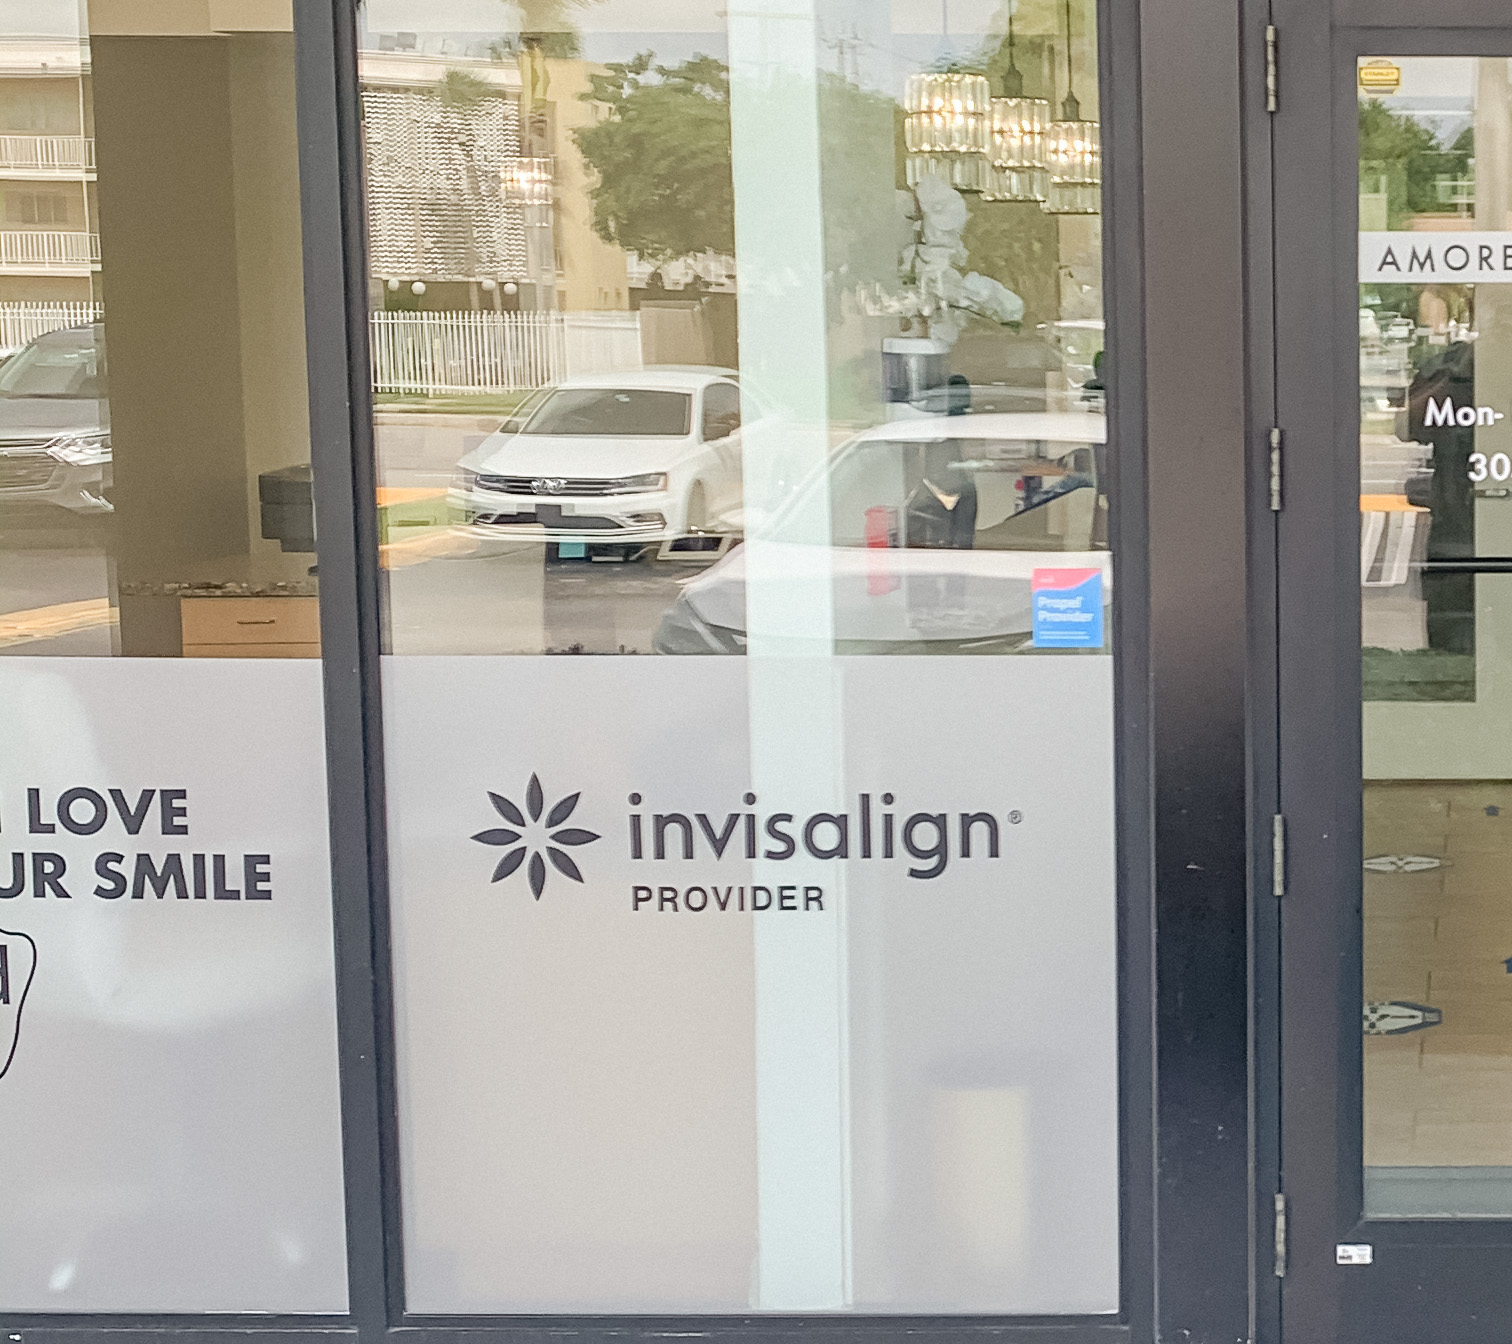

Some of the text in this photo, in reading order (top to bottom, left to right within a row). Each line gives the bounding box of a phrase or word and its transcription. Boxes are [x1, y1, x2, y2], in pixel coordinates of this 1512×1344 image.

[27, 786, 189, 836] LOVE
[93, 852, 272, 900] SMILE
[631, 885, 825, 913] PROVIDER
